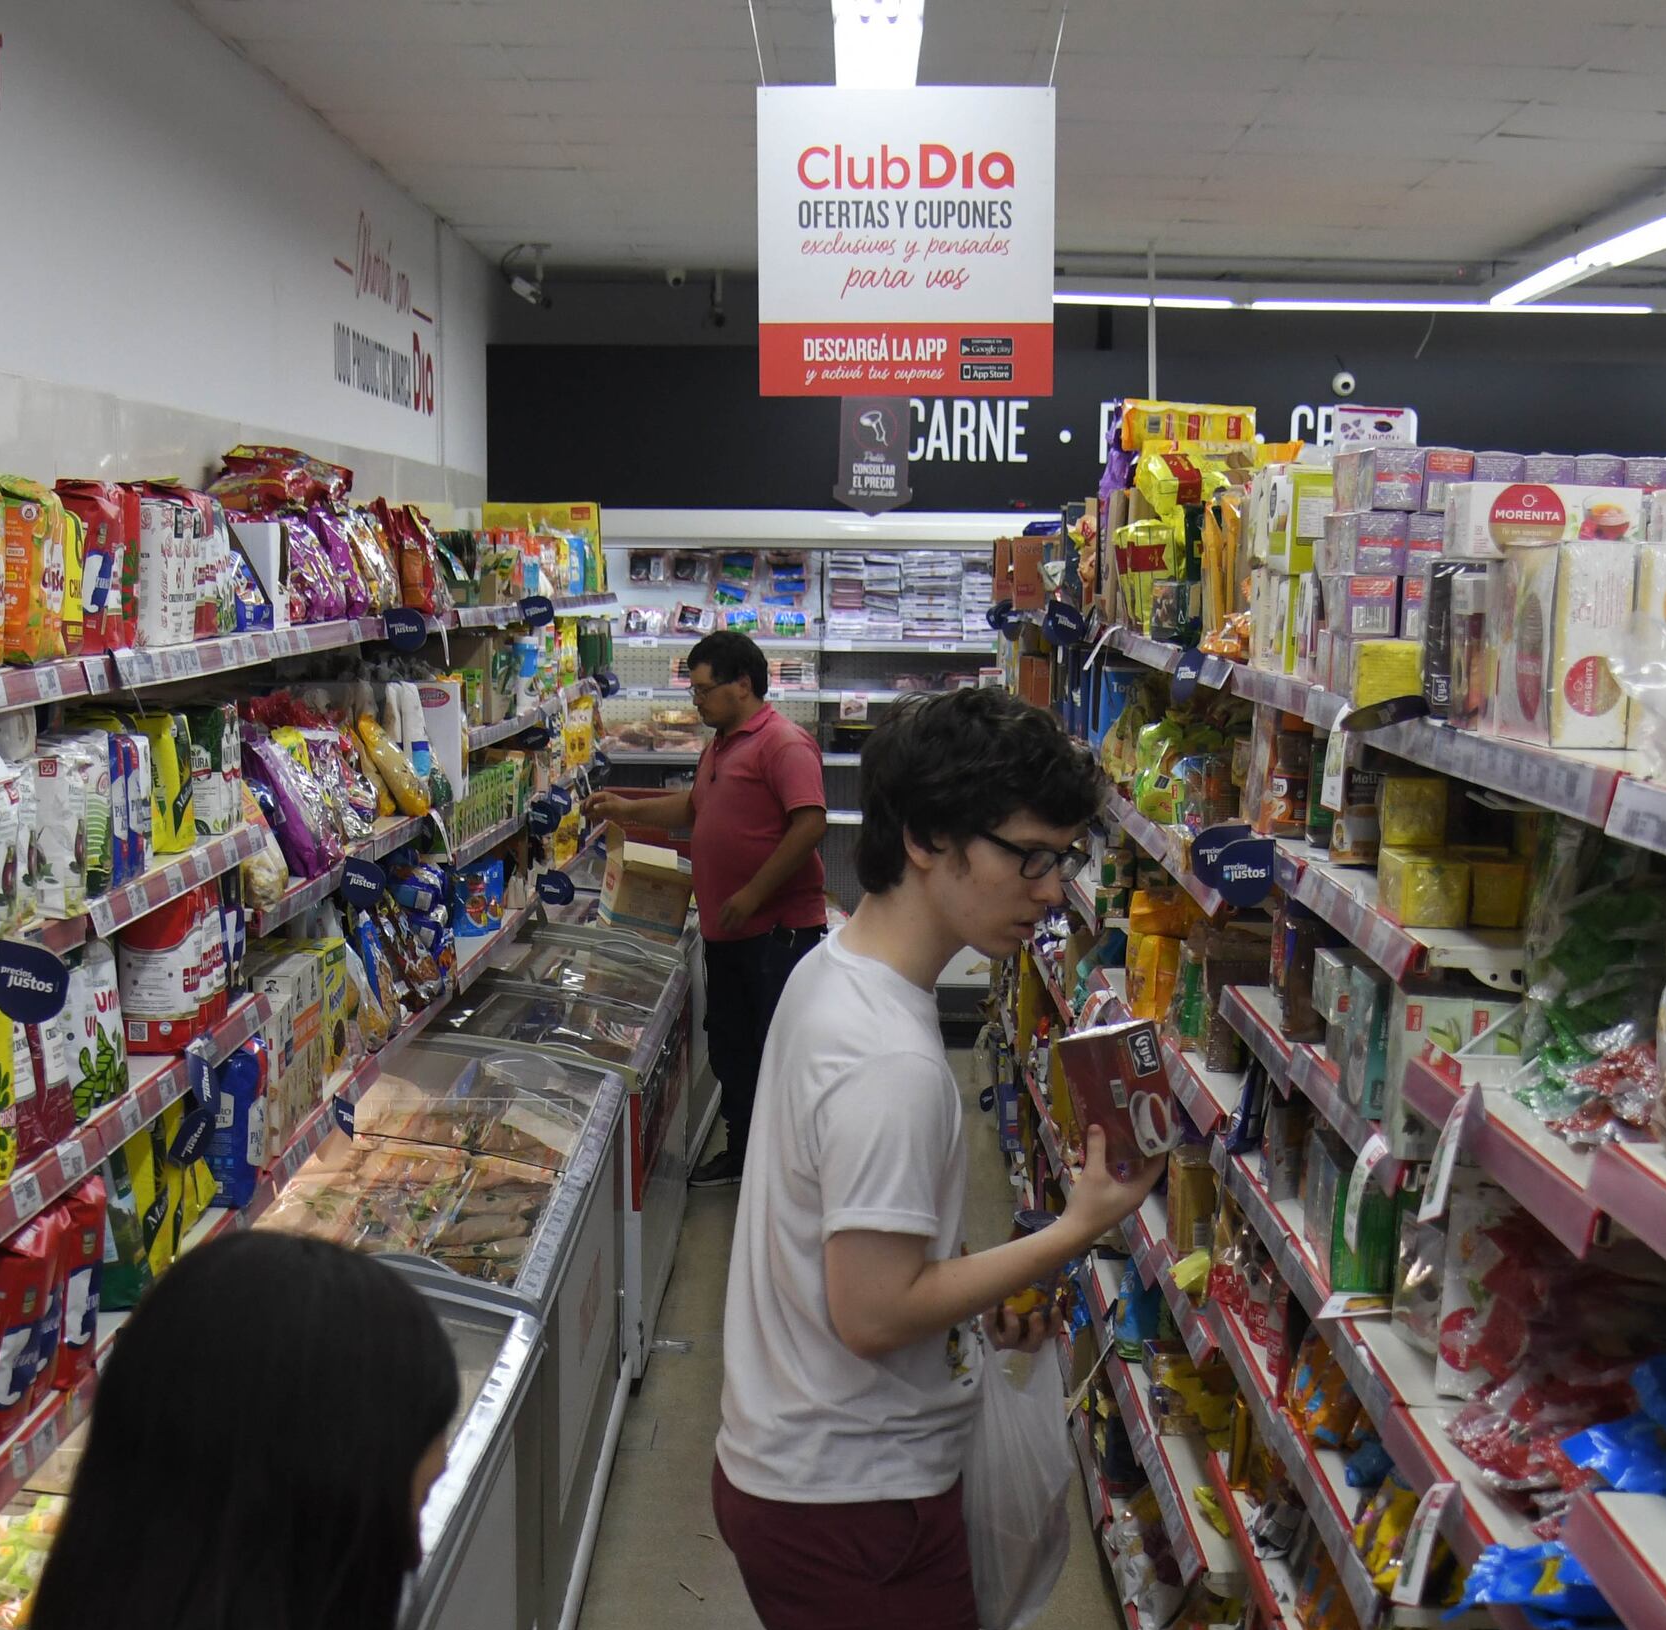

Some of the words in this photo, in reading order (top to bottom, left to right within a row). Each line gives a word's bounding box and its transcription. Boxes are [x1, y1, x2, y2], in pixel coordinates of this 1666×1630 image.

[797, 144, 911, 190] Club
[798, 200, 889, 229] OFERTAS
[895, 200, 909, 229] Y
[914, 200, 1013, 229] CUPONES
[801, 231, 897, 257] exclusivos
[903, 241, 921, 263] y
[923, 232, 1011, 261] pensados
[841, 266, 915, 300] para
[925, 266, 970, 291] vos
[803, 333, 888, 362] DESCARGÁ
[892, 339, 912, 362] LA
[915, 338, 948, 362] APP
[971, 345, 996, 356] Google
[997, 346, 1012, 358] play
[804, 368, 818, 386] y
[821, 364, 863, 380] activá
[868, 365, 889, 381] tus
[894, 366, 945, 386] cupones
[972, 370, 987, 382] App
[988, 370, 1010, 381] Store
[908, 399, 1029, 463] CARNE
[853, 464, 896, 476] CONSULTAR
[853, 477, 863, 489] EL
[864, 476, 895, 489] PRECIO
[1495, 508, 1561, 522] MORENITA
[1583, 659, 1595, 713] MORENITA
[190, 756, 209, 769] TURA
[1223, 863, 1247, 873] precios
[1231, 866, 1266, 883] justos
[0, 965, 33, 979] precios
[7, 975, 54, 994] justos
